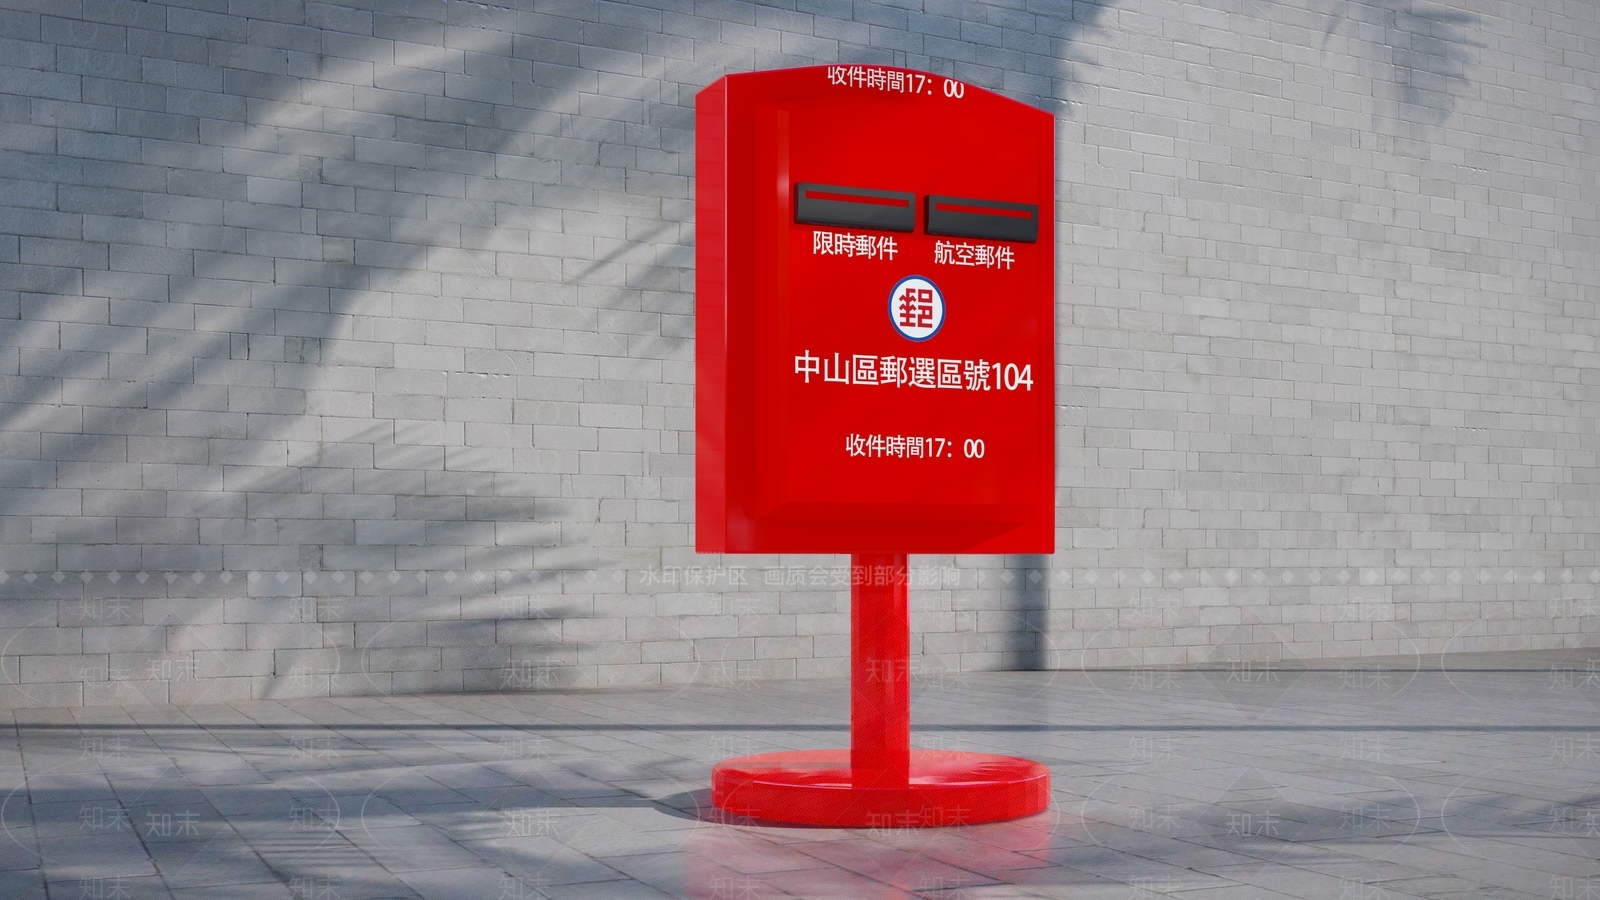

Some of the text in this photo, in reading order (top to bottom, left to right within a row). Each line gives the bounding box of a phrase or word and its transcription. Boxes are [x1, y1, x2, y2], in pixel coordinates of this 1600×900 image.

[813, 230, 898, 261] 限時郵件
[934, 239, 1015, 270] 航空郵件
[898, 287, 934, 328] 郵
[794, 349, 1034, 391] 中山區郵選區號104
